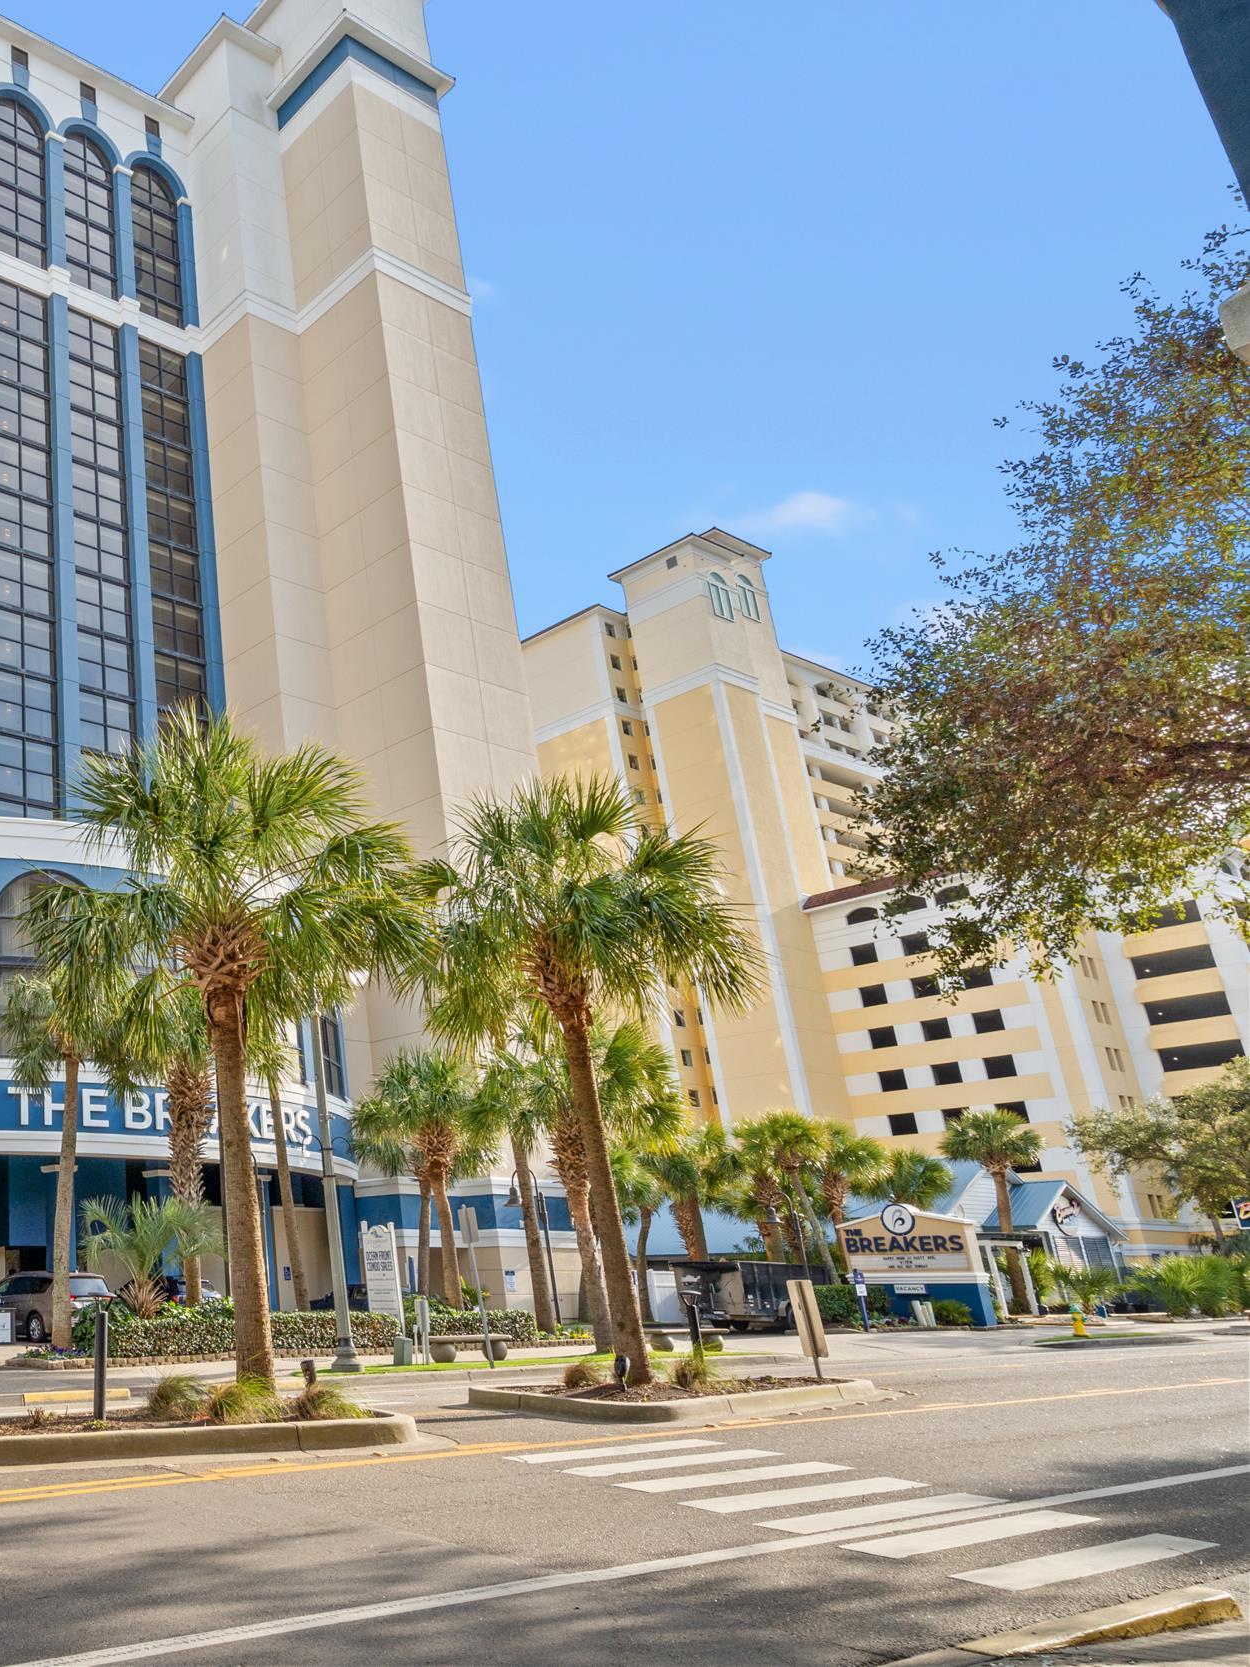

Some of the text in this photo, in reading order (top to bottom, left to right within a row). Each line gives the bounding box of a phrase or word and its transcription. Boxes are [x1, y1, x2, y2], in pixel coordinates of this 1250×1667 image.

[7, 1086, 313, 1146] THE BRKERS
[844, 1228, 863, 1237] THE
[845, 1235, 964, 1253] BREAKERS
[366, 1250, 392, 1261] OCEAN FRONT
[367, 1261, 393, 1272] CONDO SALES
